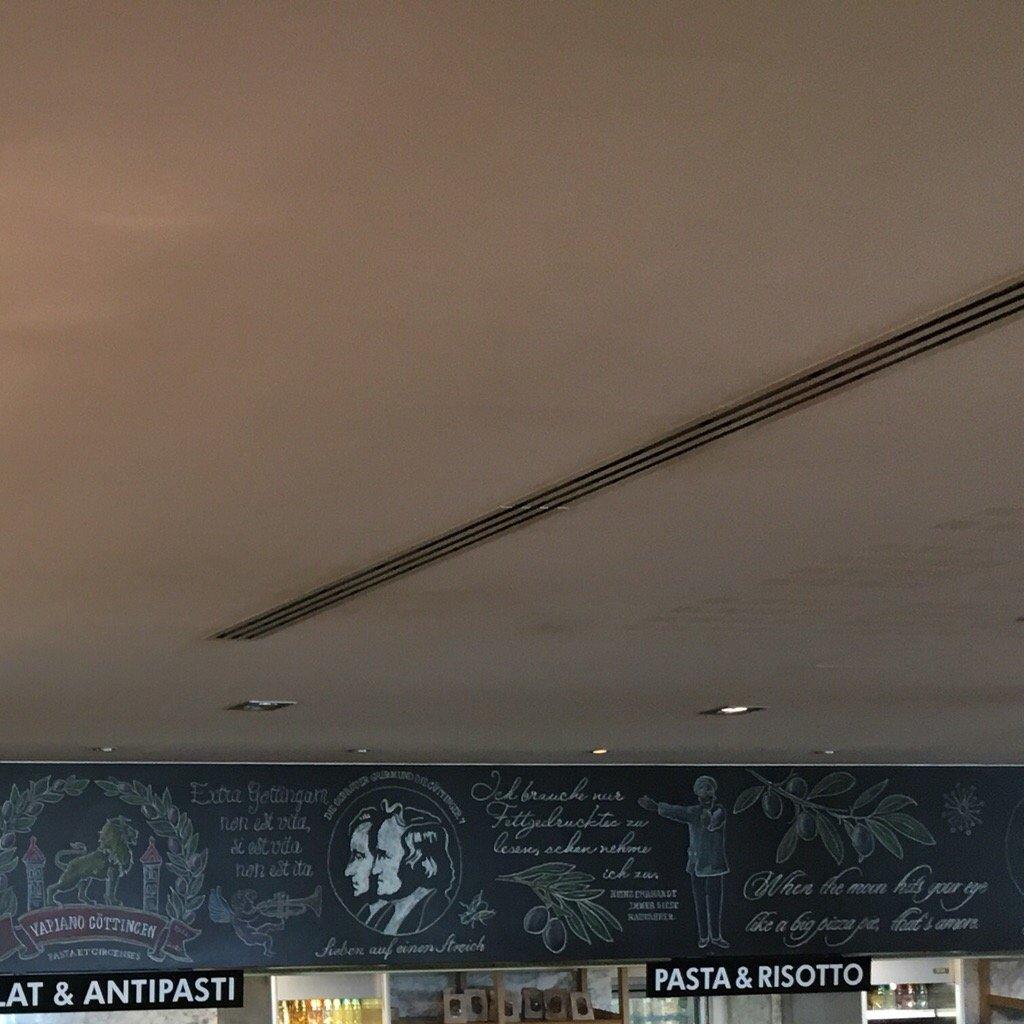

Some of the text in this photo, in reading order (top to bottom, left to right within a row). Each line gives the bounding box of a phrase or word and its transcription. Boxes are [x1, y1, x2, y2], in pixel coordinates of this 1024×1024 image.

[470, 770, 624, 802] Ich brauche nur
[220, 815, 249, 831] non
[253, 812, 275, 832] est
[324, 803, 339, 821] DIE
[625, 818, 650, 828] zu
[247, 837, 269, 855] est
[544, 830, 598, 854] schon
[599, 831, 653, 854] nehme
[236, 863, 265, 878] non
[269, 860, 290, 877] est
[602, 857, 634, 880] ich
[743, 870, 814, 901] When
[820, 866, 863, 895] the
[846, 882, 888, 895] moon
[913, 881, 963, 904] your
[940, 881, 989, 912] eye
[30, 913, 157, 939] VAPIANO GÖTTINGEN
[745, 910, 778, 932] like
[775, 919, 789, 932] a
[783, 915, 856, 948] pizza
[790, 910, 816, 940] big
[47, 949, 77, 961] PASTA
[315, 932, 485, 960] Sieben auf einen Streich
[654, 963, 864, 991] PASTA & RISOTTO
[53, 981, 74, 1006] &
[83, 976, 236, 1005] ANTIPASTI
